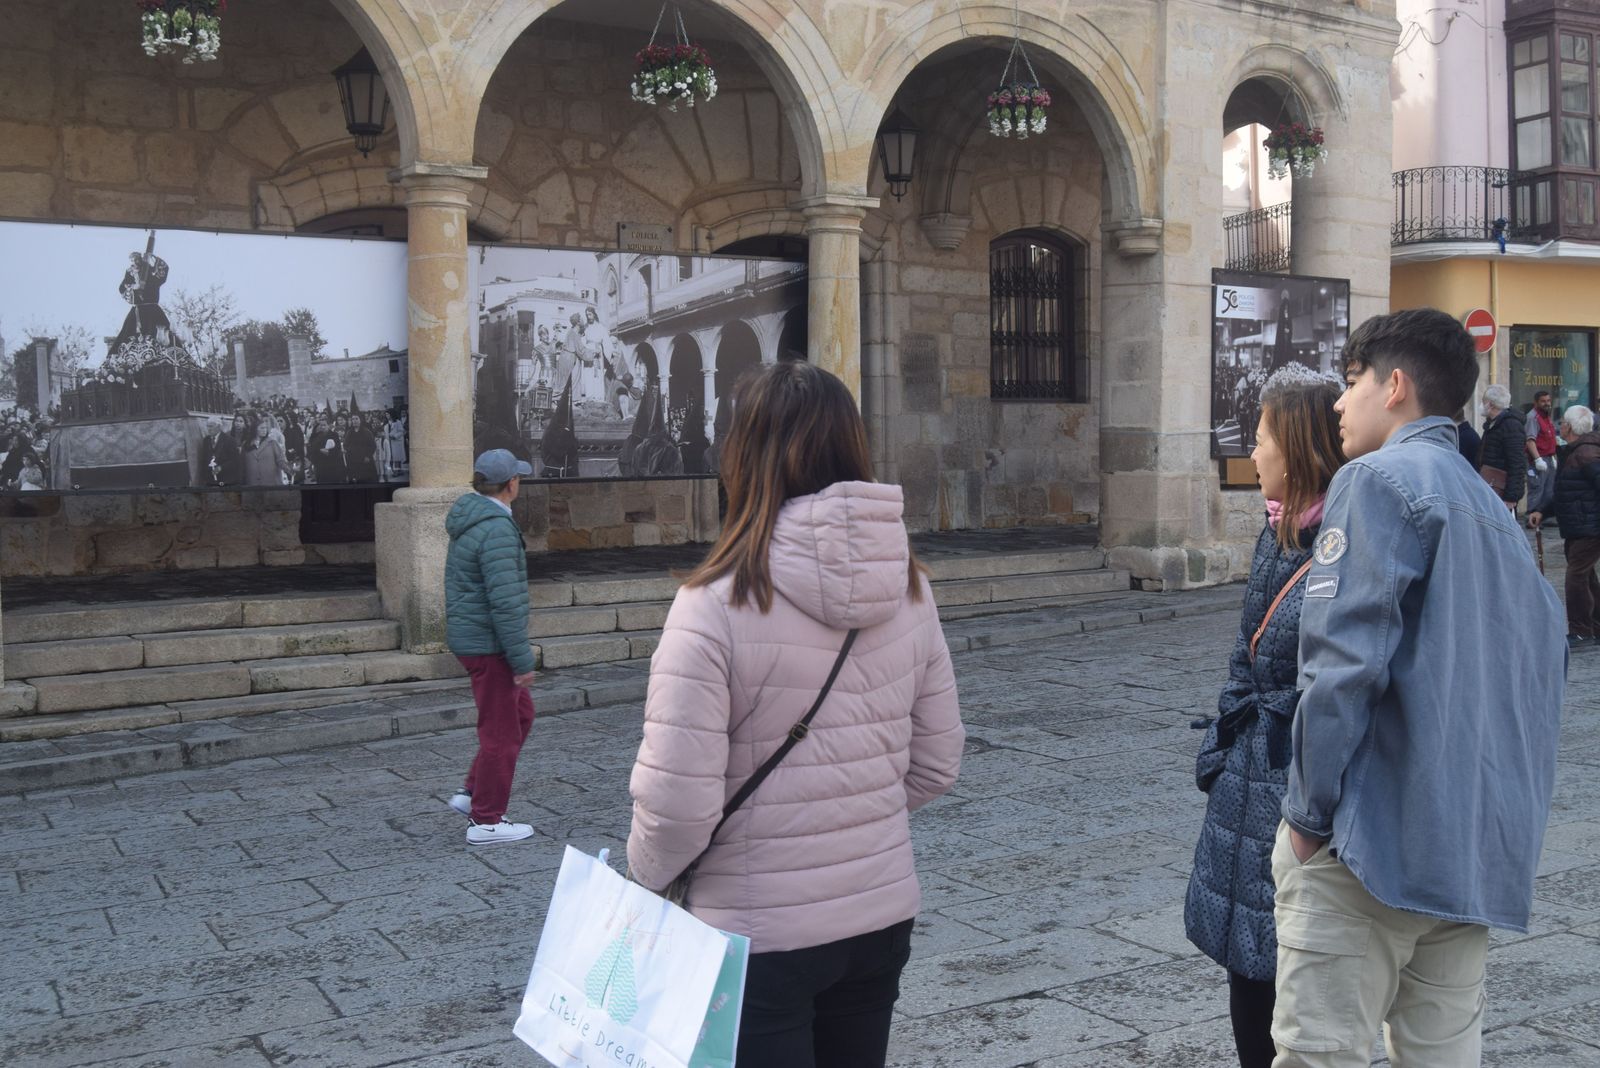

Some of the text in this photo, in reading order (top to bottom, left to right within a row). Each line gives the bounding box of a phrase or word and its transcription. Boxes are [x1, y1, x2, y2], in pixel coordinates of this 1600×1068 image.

[1514, 343, 1568, 359] El Rincón
[1523, 368, 1564, 386] Zamora
[549, 992, 655, 1068] Little Dream
